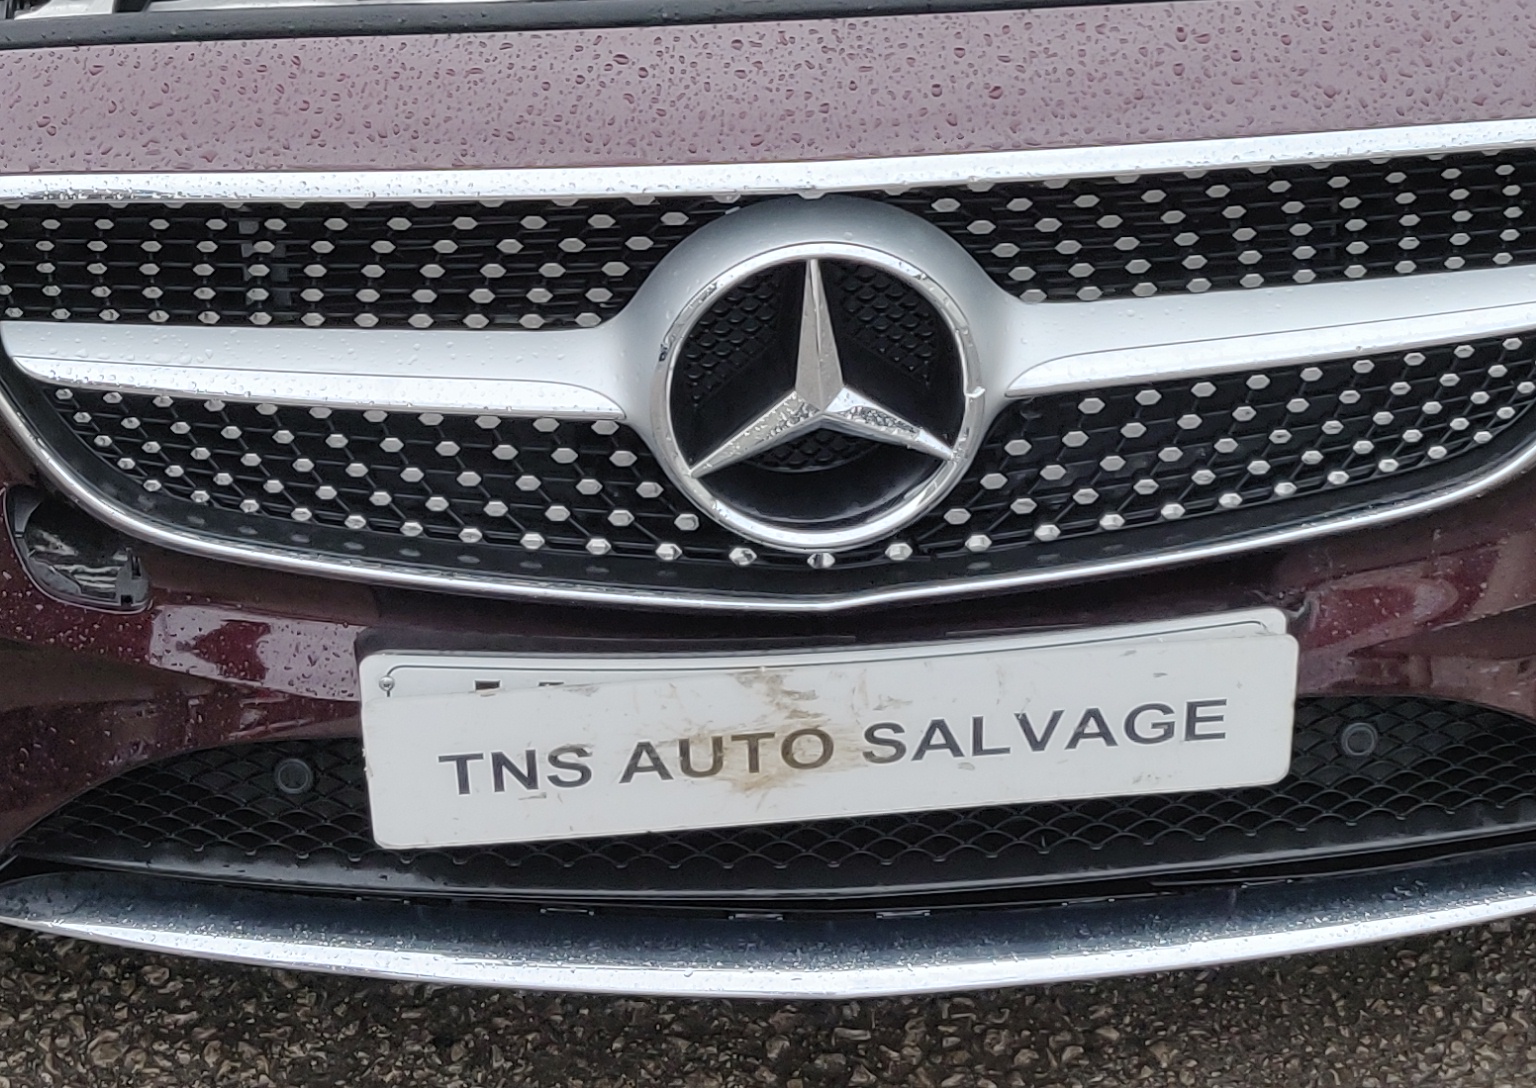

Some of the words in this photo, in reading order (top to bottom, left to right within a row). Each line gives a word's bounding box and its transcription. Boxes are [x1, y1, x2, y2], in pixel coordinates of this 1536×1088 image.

[438, 745, 593, 796] TNS
[619, 726, 835, 784] AUTO
[862, 698, 1228, 765] SALVAGE
